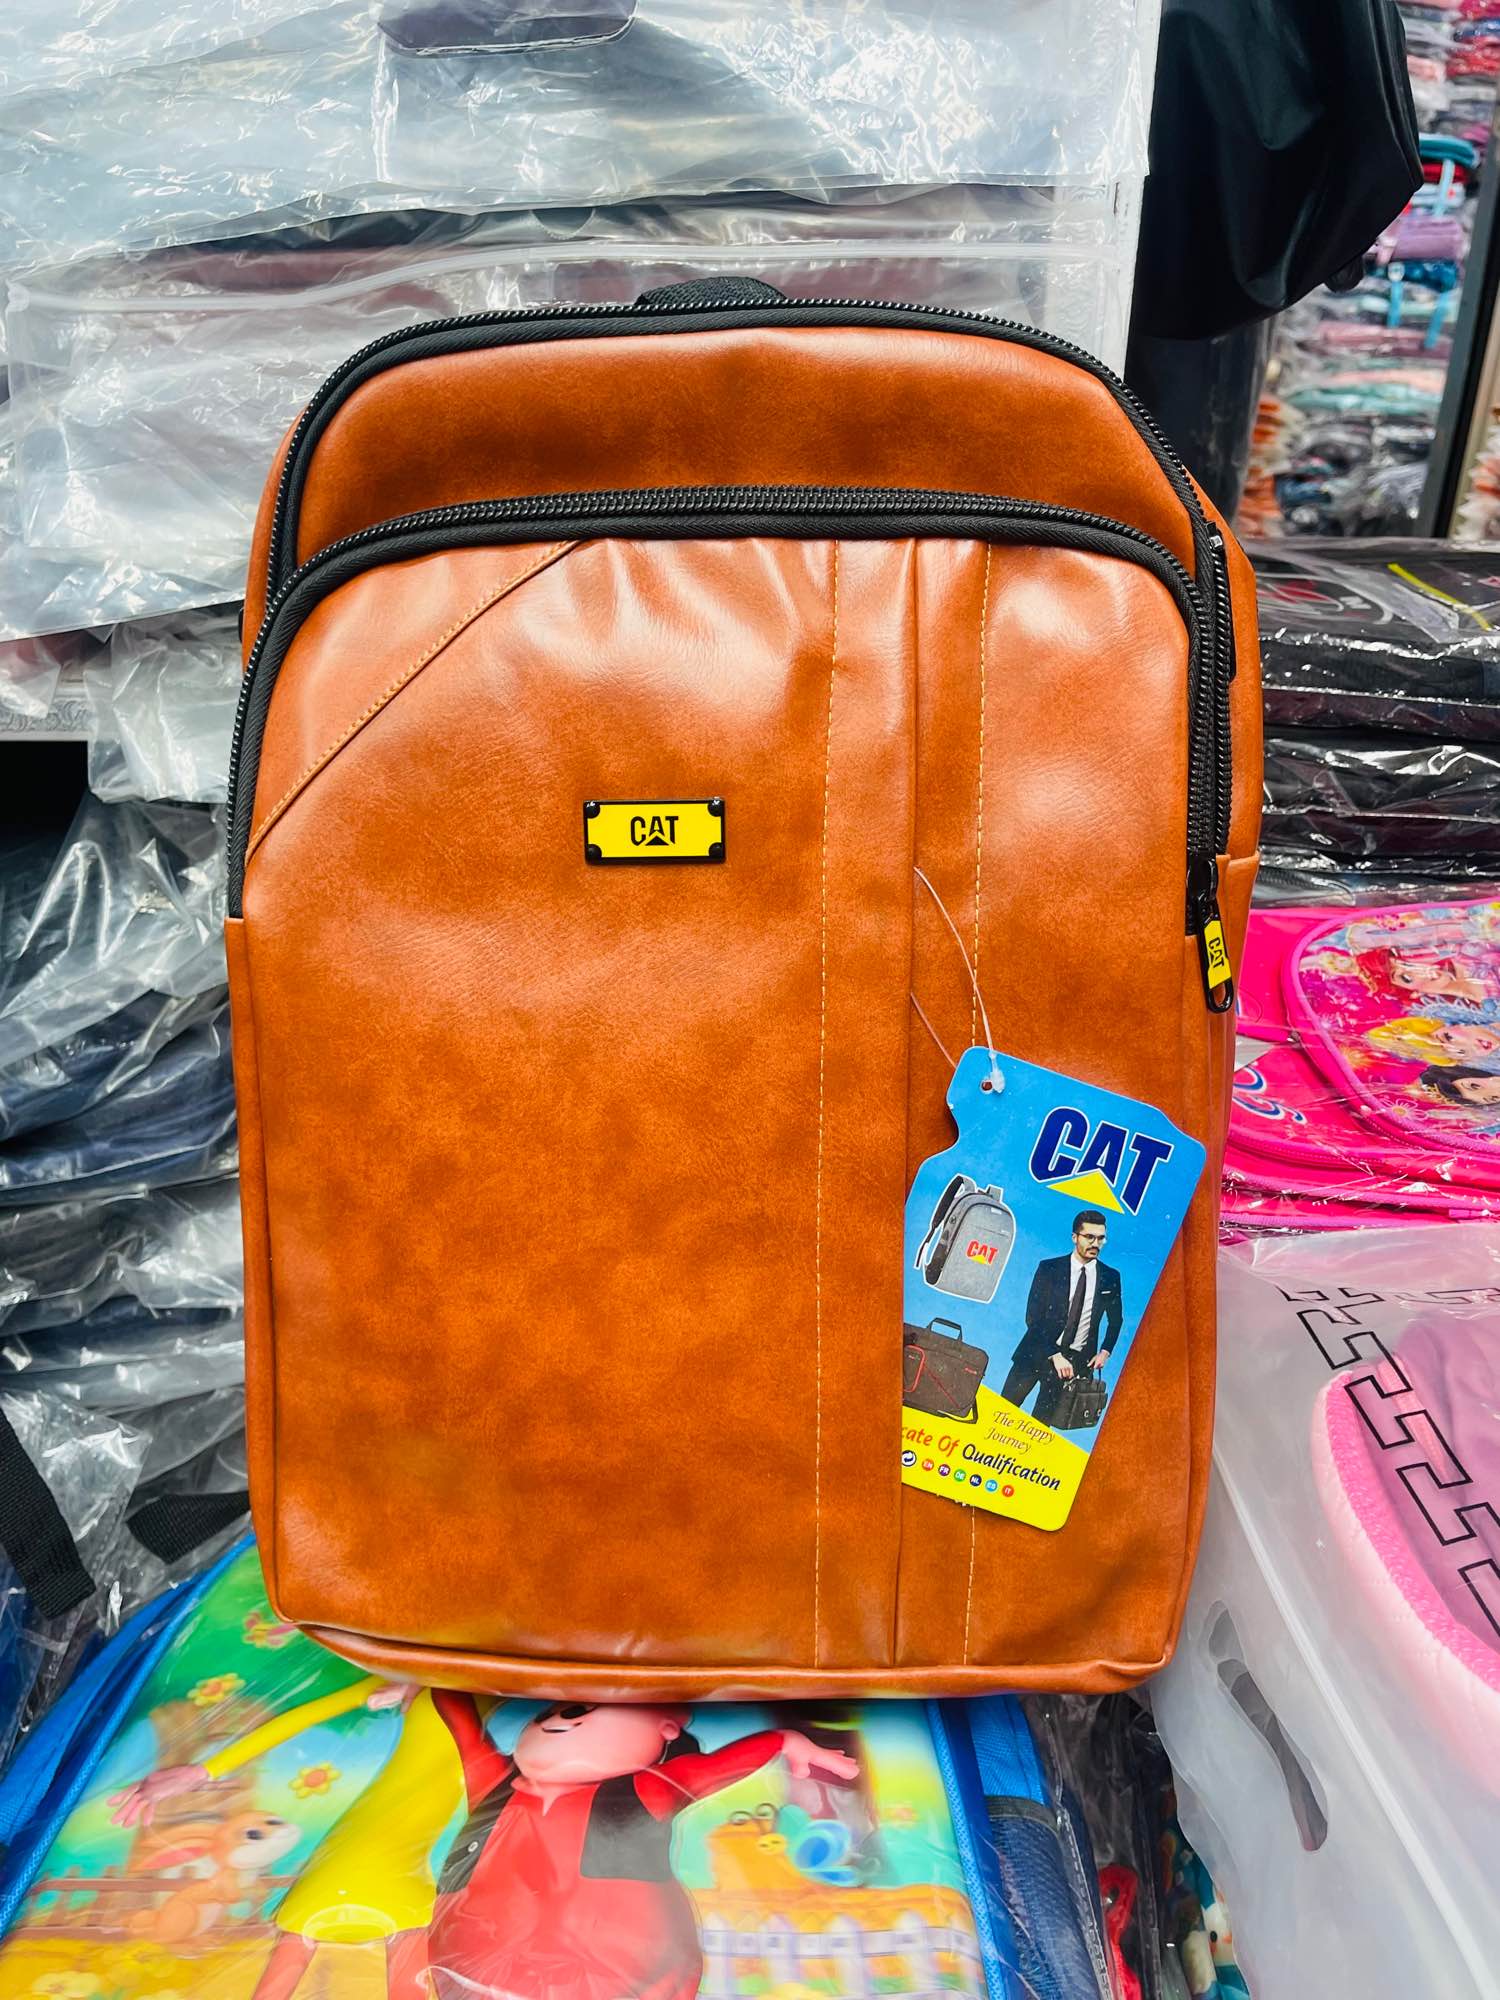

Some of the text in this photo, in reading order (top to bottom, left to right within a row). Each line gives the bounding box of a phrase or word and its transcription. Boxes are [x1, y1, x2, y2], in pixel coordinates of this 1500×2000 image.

[630, 816, 679, 846] CAT
[1208, 937, 1225, 968] CAT
[1029, 1106, 1174, 1216] CAT
[966, 1239, 999, 1265] CAT
[984, 1427, 1031, 1455] Journey
[993, 1411, 1056, 1445] The Happy
[938, 1435, 960, 1457] Of
[962, 1443, 1061, 1490] Qualification
